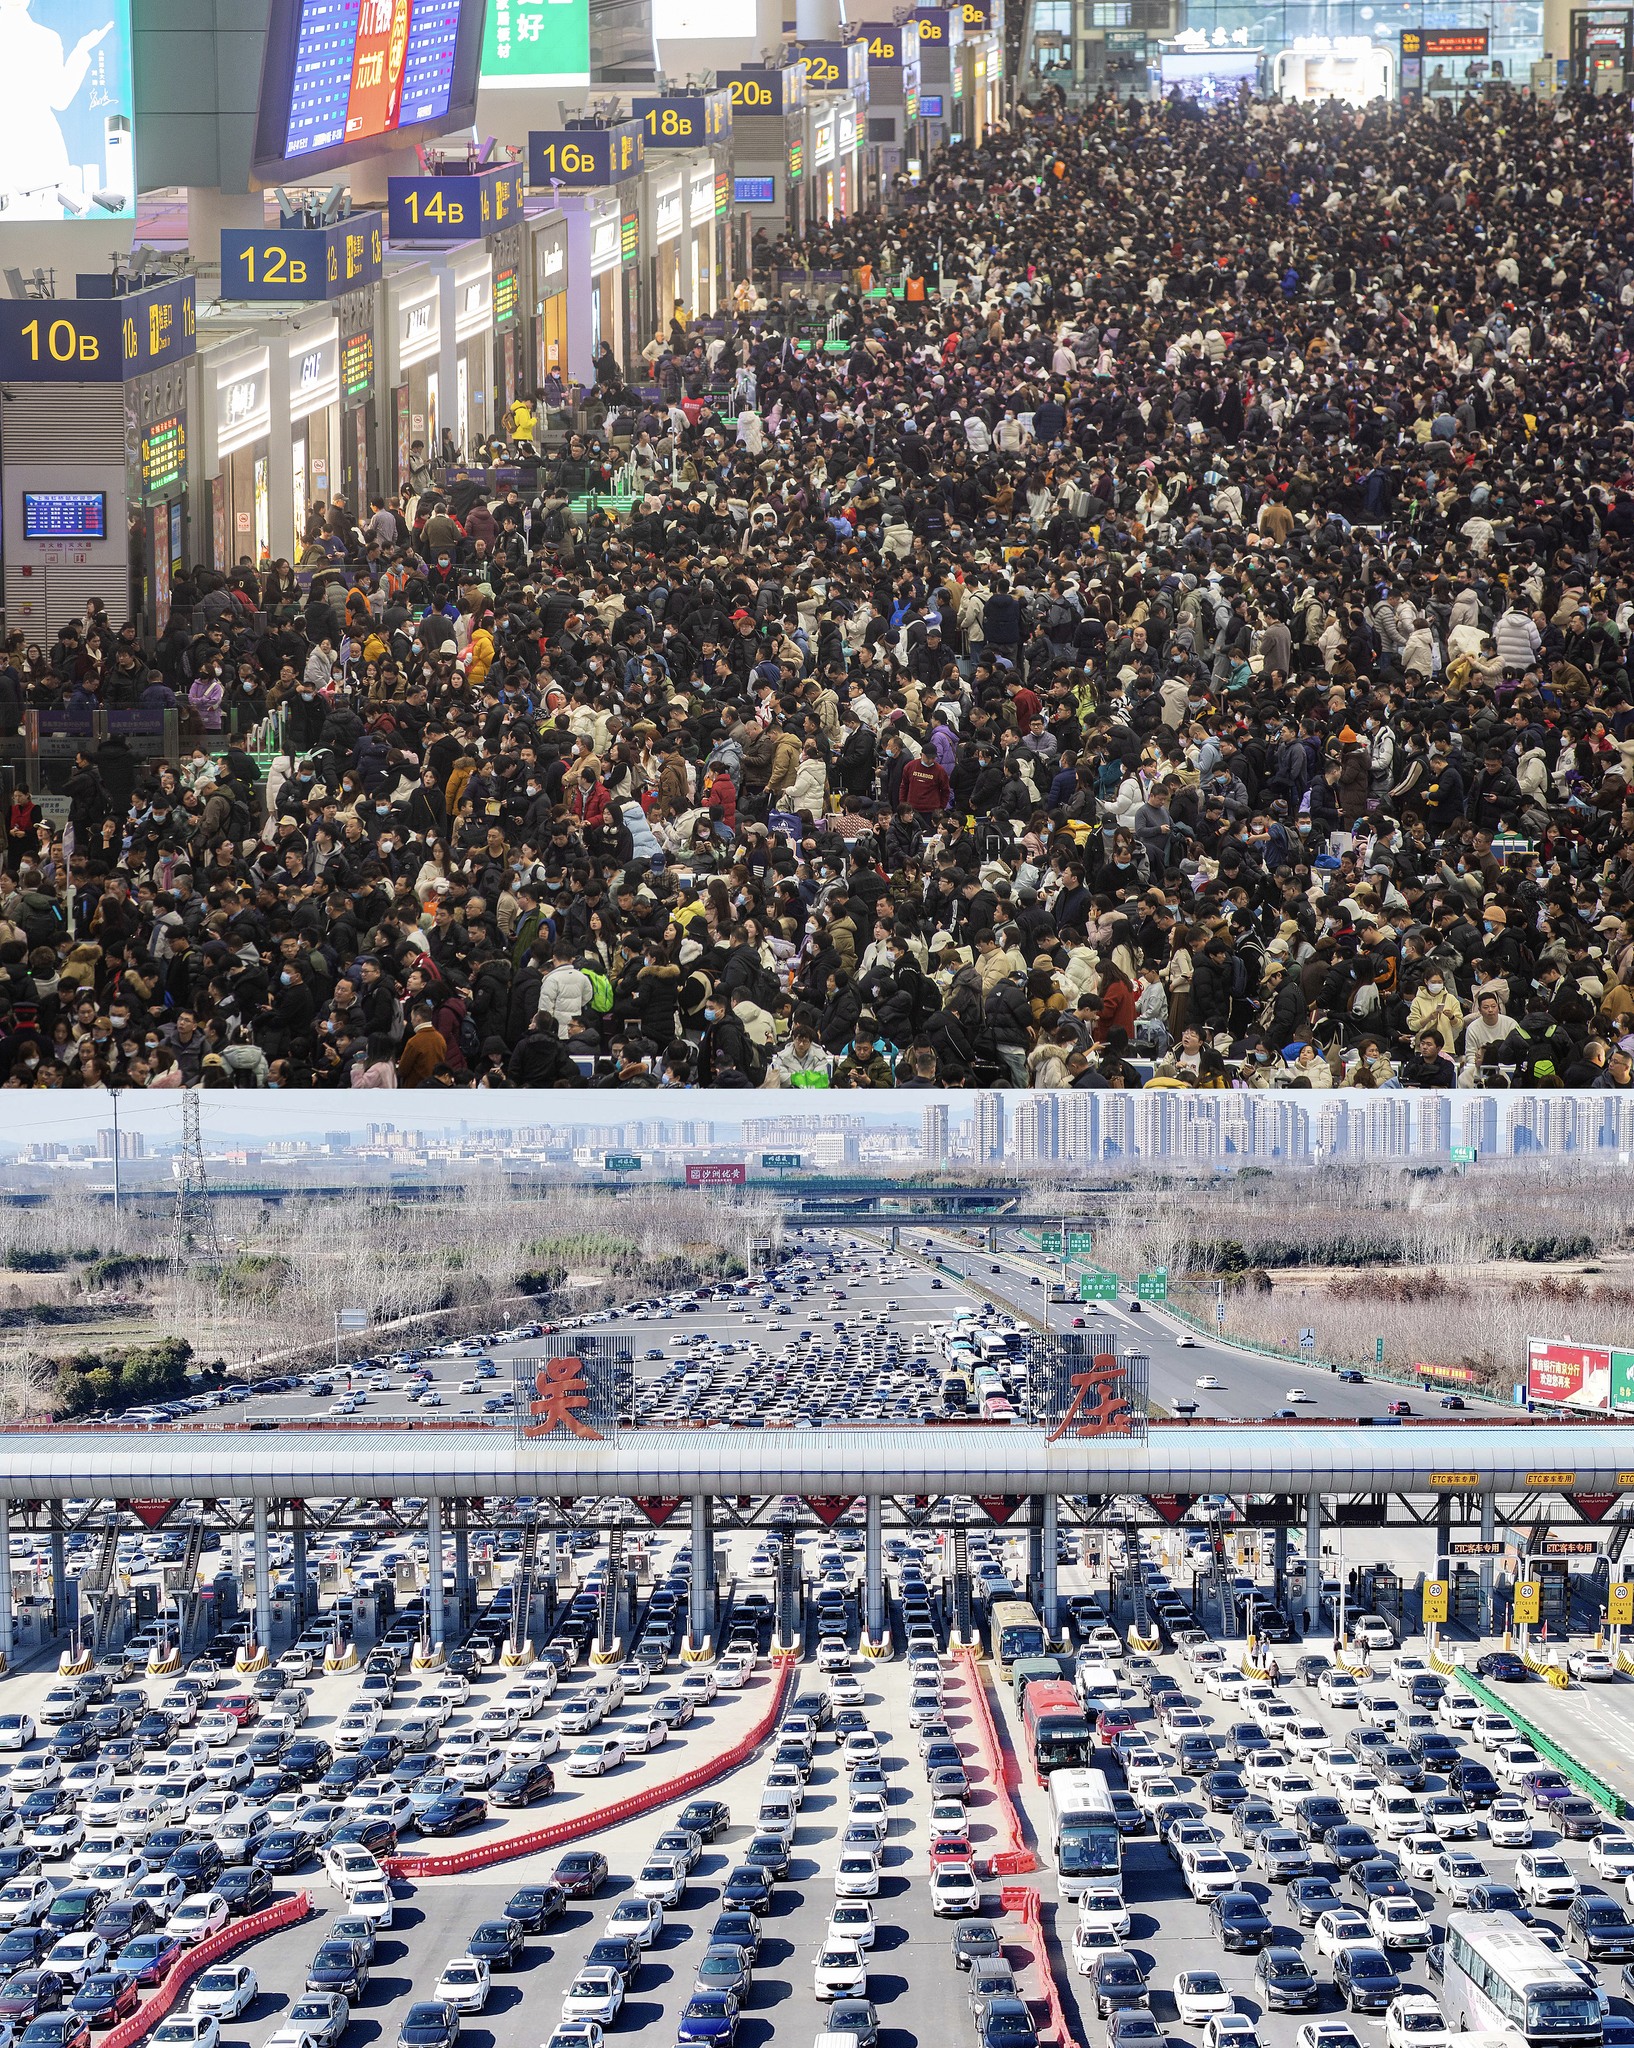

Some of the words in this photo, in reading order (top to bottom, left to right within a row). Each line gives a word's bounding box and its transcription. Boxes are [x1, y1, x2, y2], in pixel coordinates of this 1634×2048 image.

[952, 4, 984, 23] 8B
[907, 20, 942, 39] 6B
[856, 37, 895, 58] 4B
[727, 81, 773, 105] 20B
[645, 109, 693, 136] 18B
[543, 144, 595, 173] 16B
[404, 191, 464, 224] 14B
[371, 229, 382, 264] 13B
[239, 246, 307, 283] 12B
[327, 245, 338, 282] 12B
[158, 304, 173, 331] 检票口
[183, 296, 195, 337] 11B
[21, 319, 100, 361] 10B
[123, 317, 138, 360] 10B
[1540, 1373, 1571, 1389] 欢迎您再来
[522, 1357, 604, 1441] 吴
[1046, 1353, 1133, 1442] 庄
[1432, 1475, 1476, 1483] ETC客车专用
[1528, 1475, 1572, 1483] ETC客车专用
[1454, 1543, 1499, 1553] ETC客车专用
[1546, 1543, 1592, 1553] ETC客车专用
